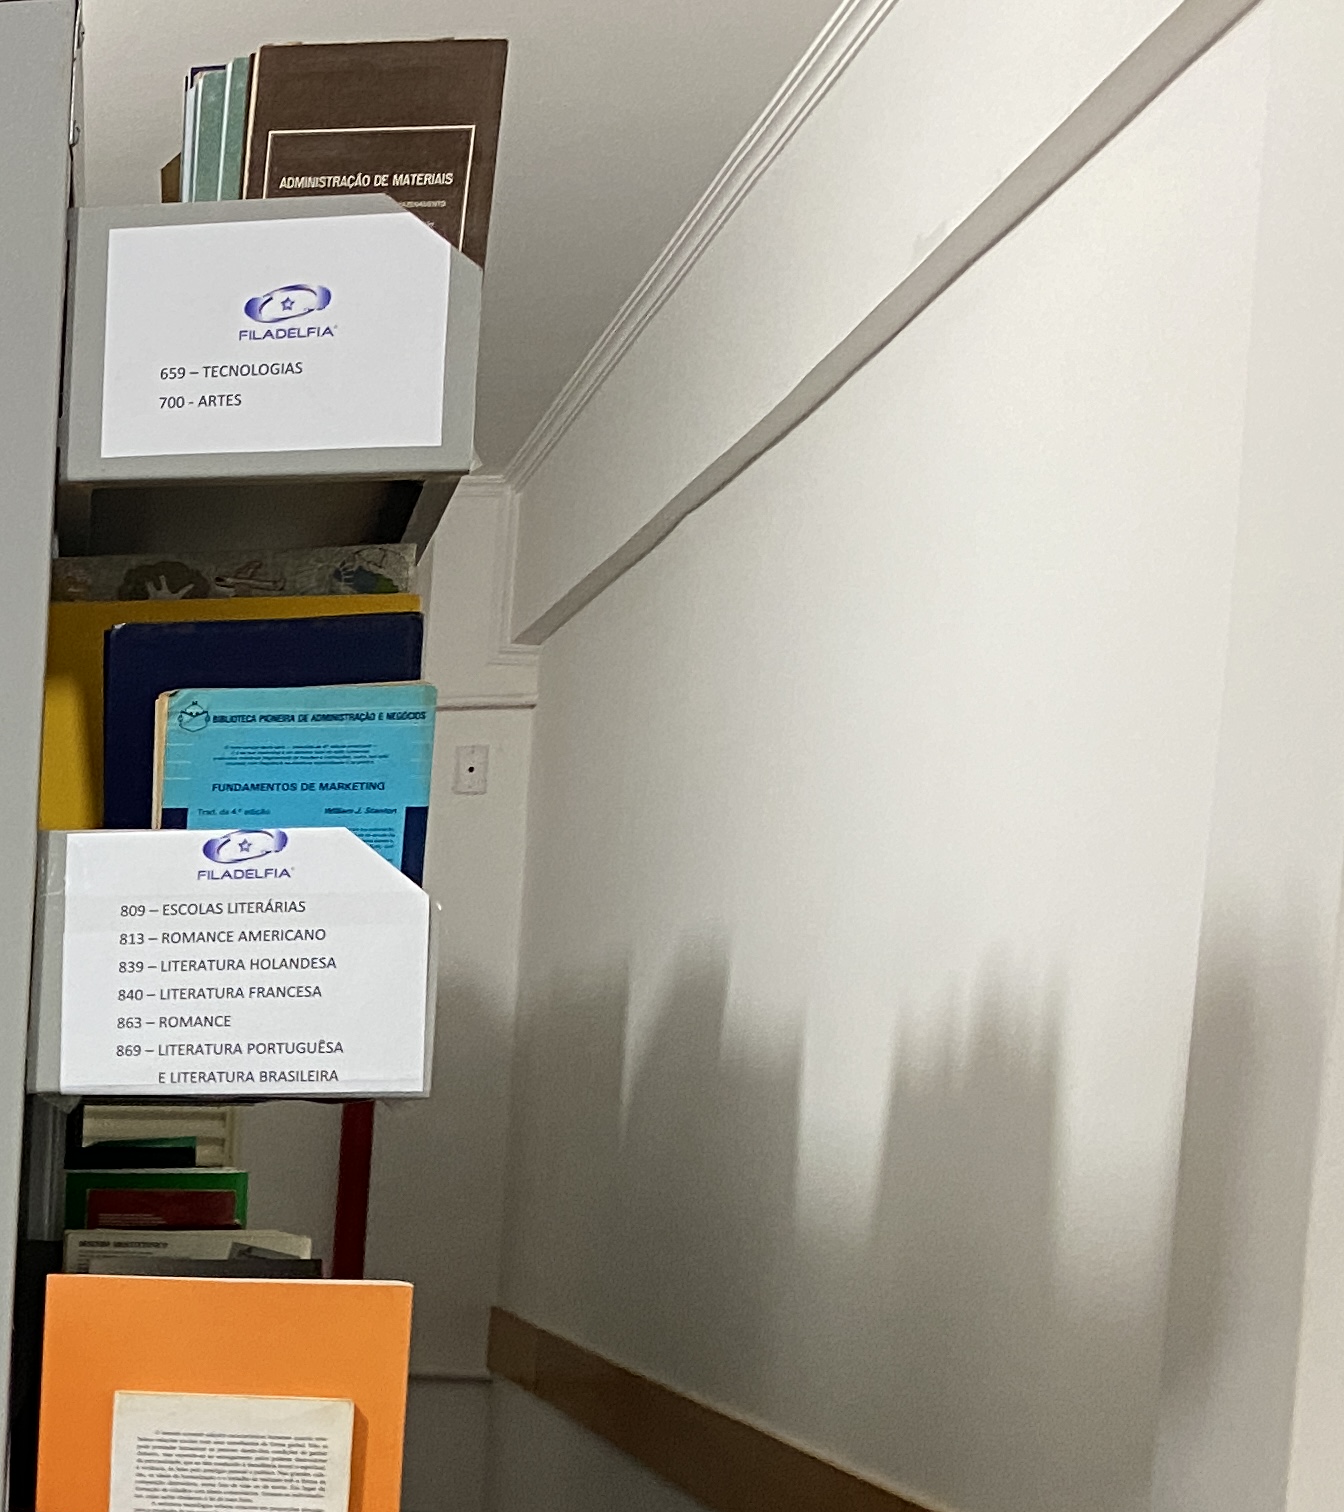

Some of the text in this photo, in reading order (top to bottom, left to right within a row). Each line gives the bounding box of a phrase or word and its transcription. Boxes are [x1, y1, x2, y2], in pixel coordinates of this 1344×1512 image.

[279, 173, 453, 189] ADMINISTRAÇÃO DE MATERIAIS
[239, 327, 334, 340] FILADELFIA
[161, 362, 302, 379] 659 TECNOLOGIAS
[159, 394, 241, 408] 700 ARTES
[213, 715, 256, 723] BIBLIOTECA
[298, 714, 309, 722] DE
[311, 712, 375, 722] ADMINISTRAÇÃO
[378, 712, 383, 720] E
[386, 711, 426, 720] NEGÓCIOS
[212, 782, 385, 791] FUNDAMENTOS DE MARKETING
[198, 869, 291, 880] FILADELFIA
[121, 899, 305, 917] 809 ESCOLAS LITERÁRIAS
[120, 929, 325, 945] 813 ROMANCE AMERICANO
[119, 957, 336, 973] 839 LITERATURA HOLANDESA
[118, 986, 321, 1001] 840 LITERATURA FRANCESA
[117, 1016, 231, 1028] 863 ROMANCE
[116, 1040, 343, 1056] 869 LITERATURA PORTUGUÊSA
[159, 1070, 338, 1083] E LITERATURA BRASILEIRA
